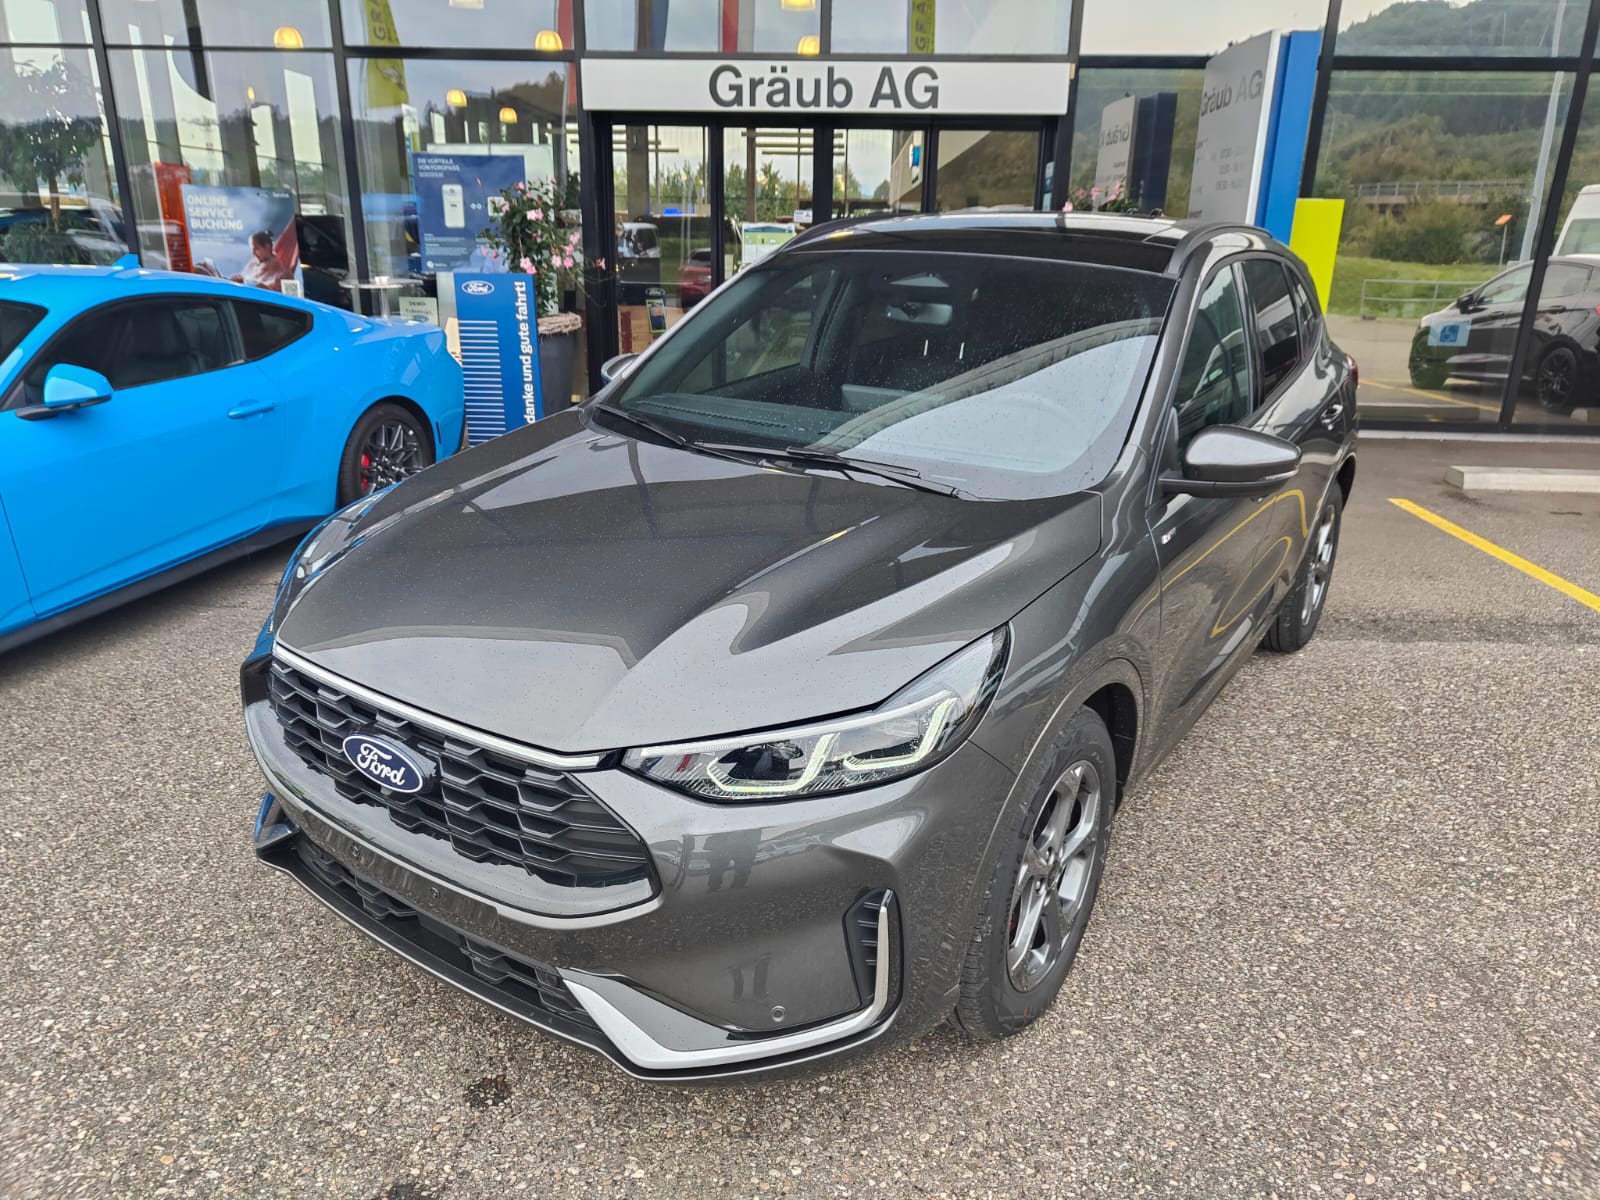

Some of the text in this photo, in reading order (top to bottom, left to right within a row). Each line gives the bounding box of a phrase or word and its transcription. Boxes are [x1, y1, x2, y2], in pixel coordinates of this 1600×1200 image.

[708, 64, 940, 110] Gräub AG
[1234, 69, 1264, 105] AG
[187, 194, 229, 207] ONLINE
[189, 206, 235, 219] SERVICE
[191, 219, 244, 231] BUCHUNG
[513, 280, 536, 424] danke und gute fahrt!
[356, 742, 406, 786] Ford
